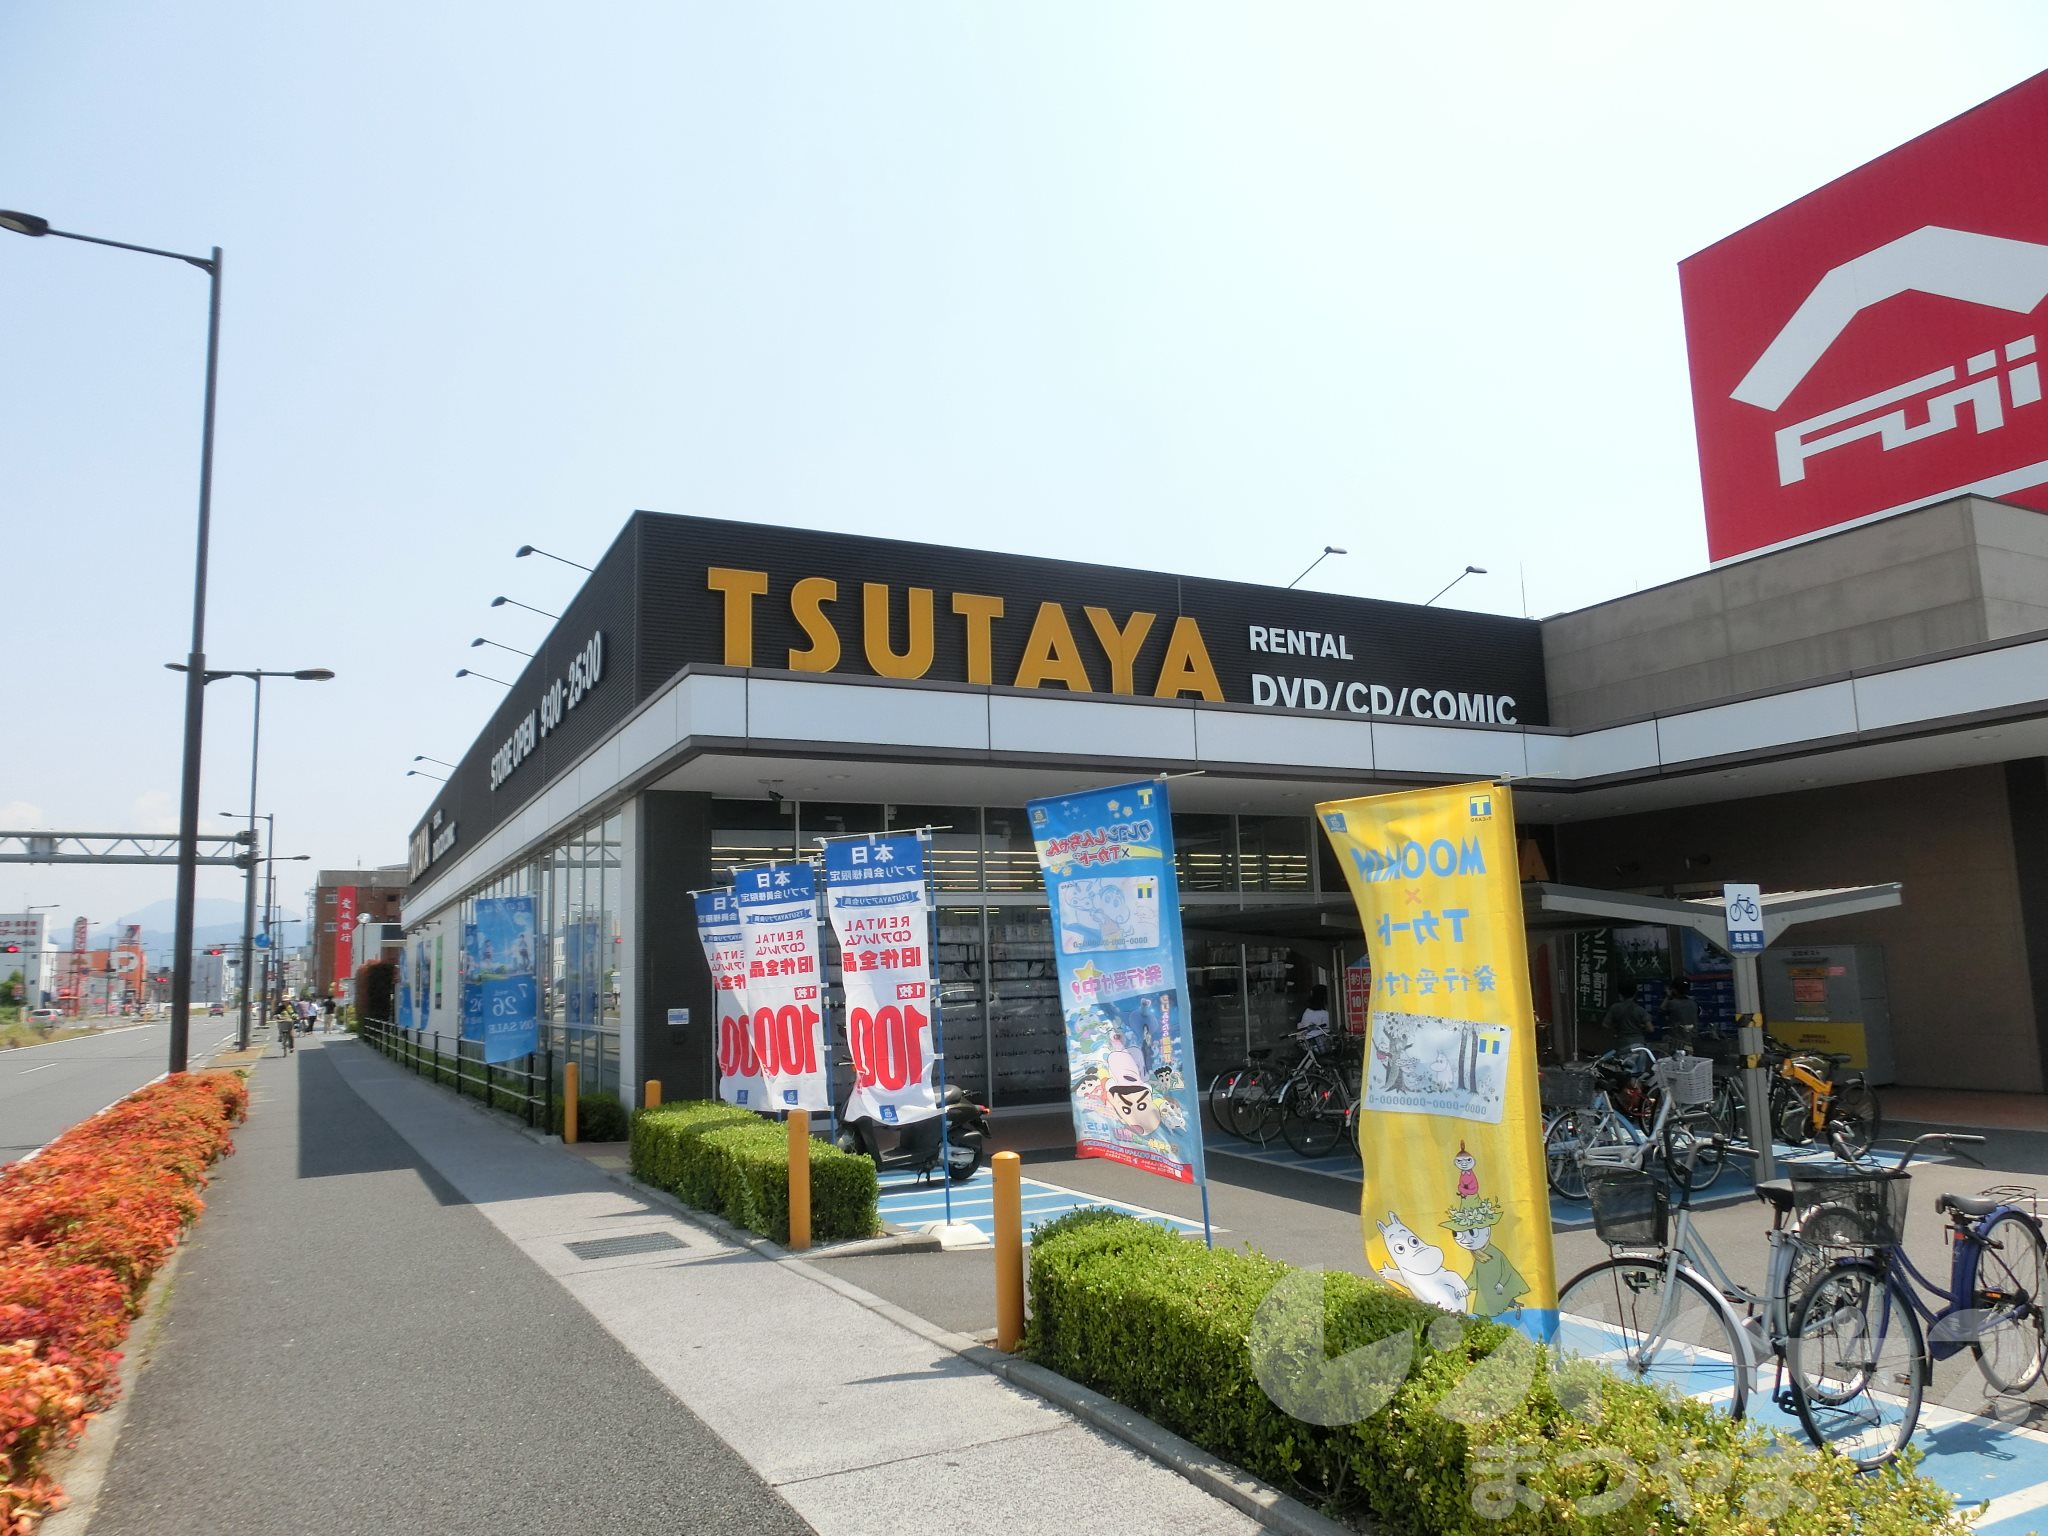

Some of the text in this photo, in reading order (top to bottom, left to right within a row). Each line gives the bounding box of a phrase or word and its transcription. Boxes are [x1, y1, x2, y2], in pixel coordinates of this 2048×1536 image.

[706, 566, 1226, 704] TSUTAYA
[1248, 624, 1355, 661] RENTAL
[1250, 672, 1518, 727] DVD/CD/COMIC
[490, 736, 514, 791] STORE
[512, 709, 537, 768] OPEN
